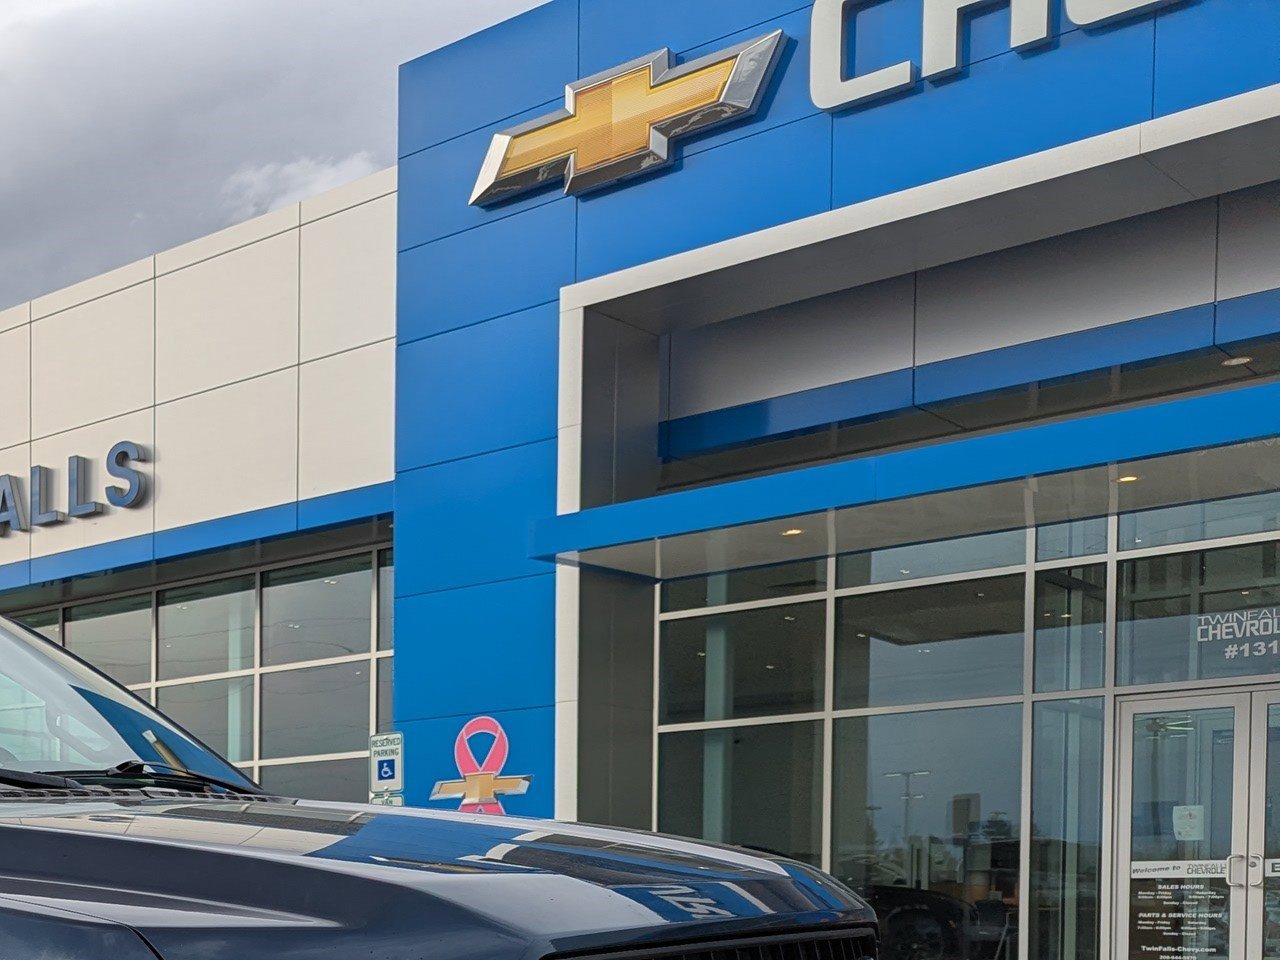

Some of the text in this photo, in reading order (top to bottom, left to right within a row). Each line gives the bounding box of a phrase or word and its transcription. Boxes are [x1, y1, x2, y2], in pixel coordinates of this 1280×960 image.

[371, 737, 401, 748] RESERVED
[373, 748, 400, 758] PARKING
[1132, 866, 1170, 874] Welcome
